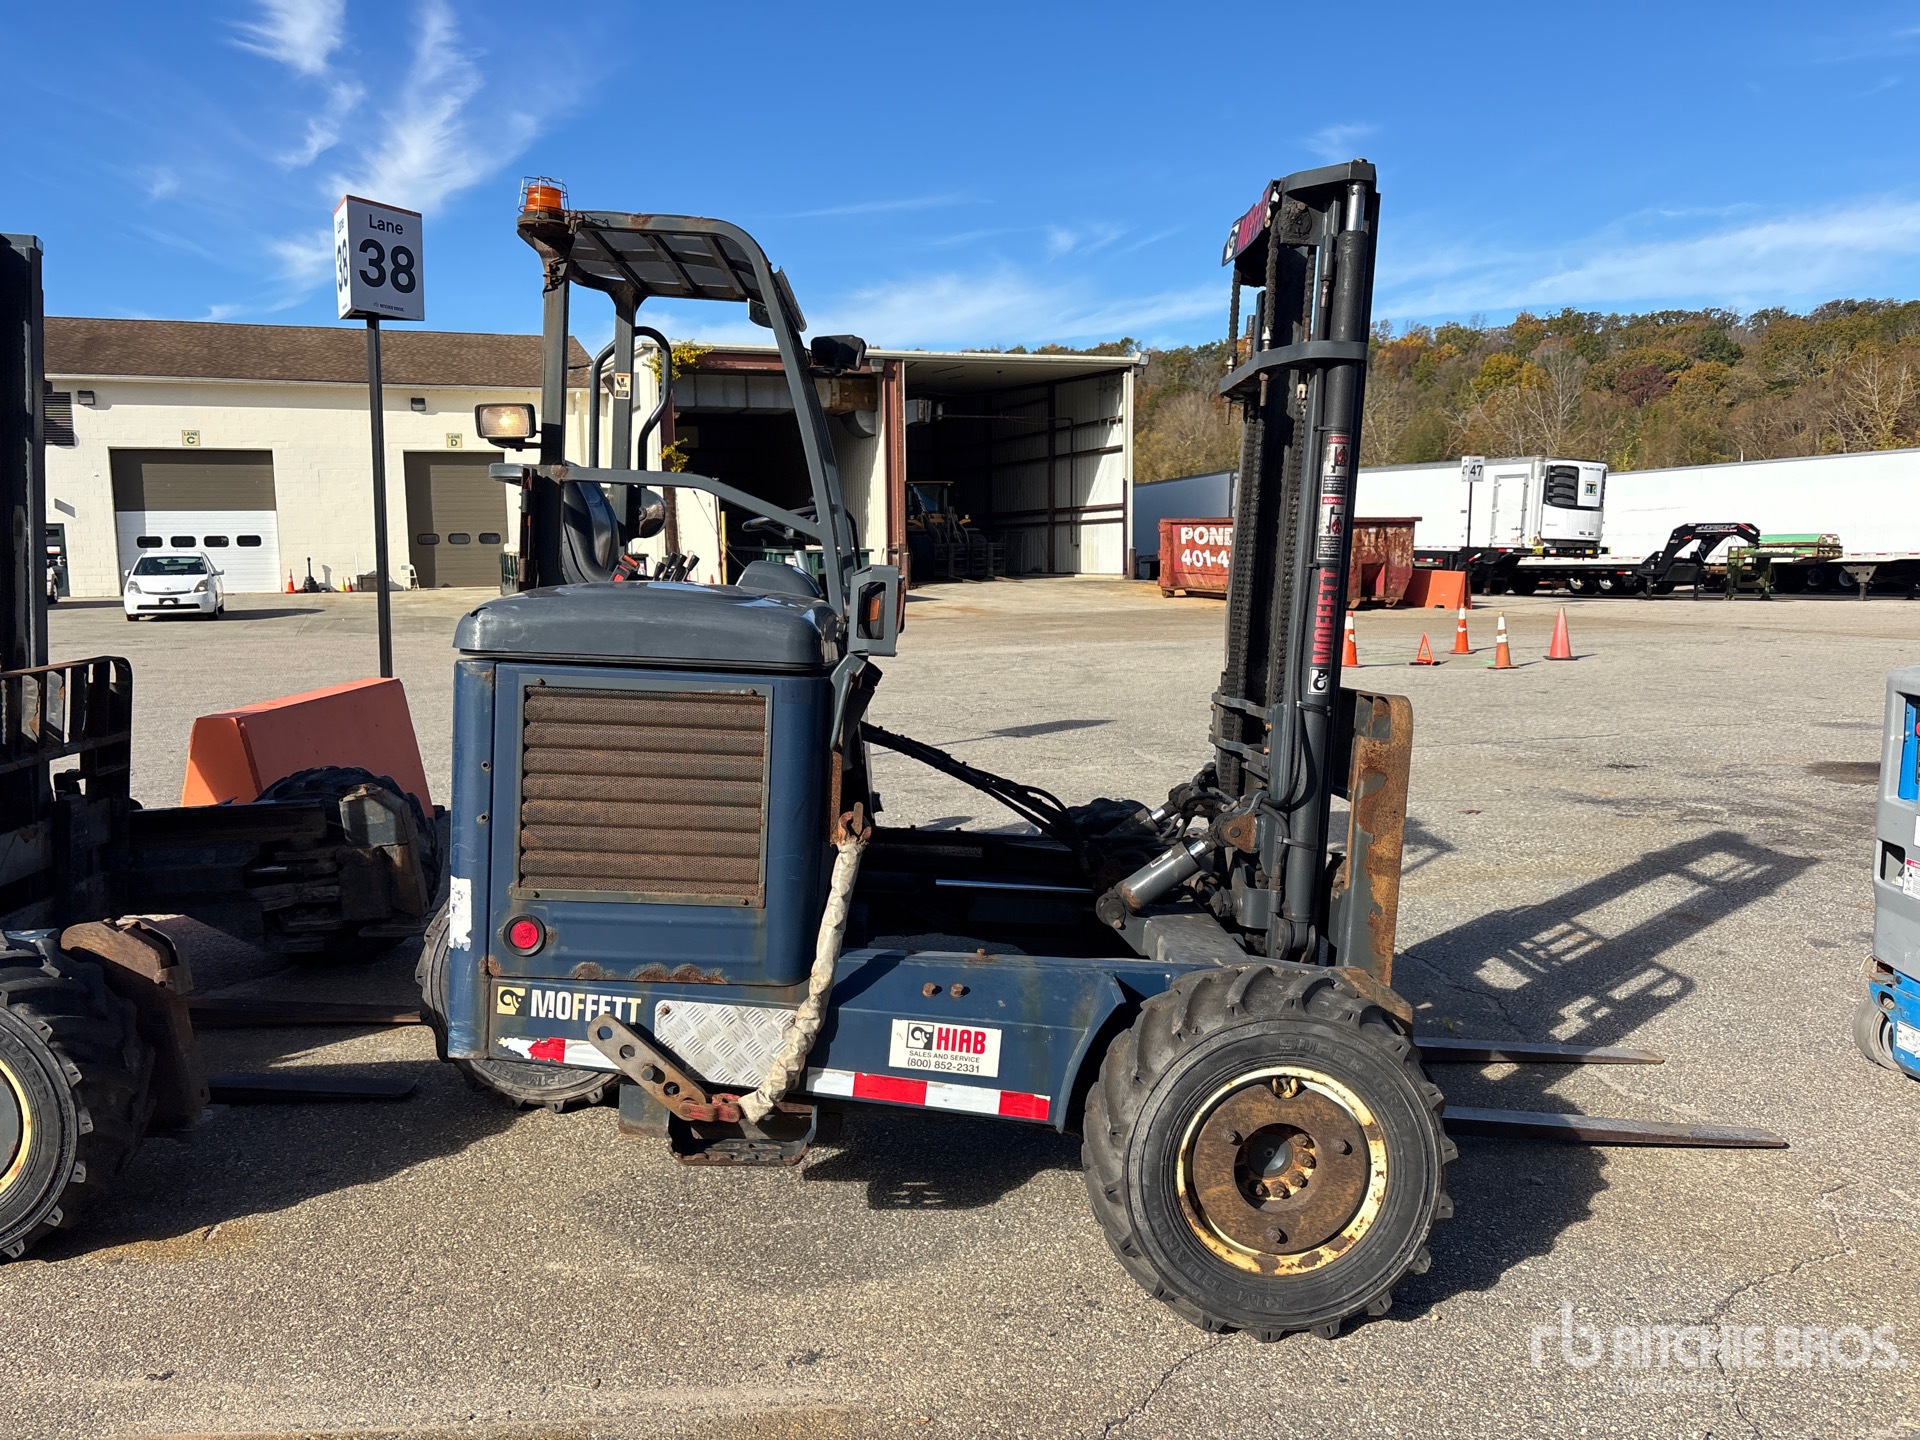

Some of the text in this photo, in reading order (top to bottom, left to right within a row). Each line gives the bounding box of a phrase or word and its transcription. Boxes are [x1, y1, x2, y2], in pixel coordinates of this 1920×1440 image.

[369, 214, 404, 235] Lane
[359, 239, 416, 293] 38
[186, 436, 195, 444] C
[450, 438, 458, 447] D
[1470, 464, 1483, 476] 47
[1181, 549, 1231, 568] 401-4
[1312, 568, 1338, 664] MOFFETT
[530, 989, 642, 1025] MOFFETT
[936, 1027, 987, 1055] HIAB
[907, 1057, 980, 1073] (800) 852-2331
[909, 1050, 932, 1059] SALES
[950, 1054, 980, 1063] SERVICE
[1279, 1039, 1367, 1073] SUPER
[1154, 1218, 1221, 1291] GUARD
